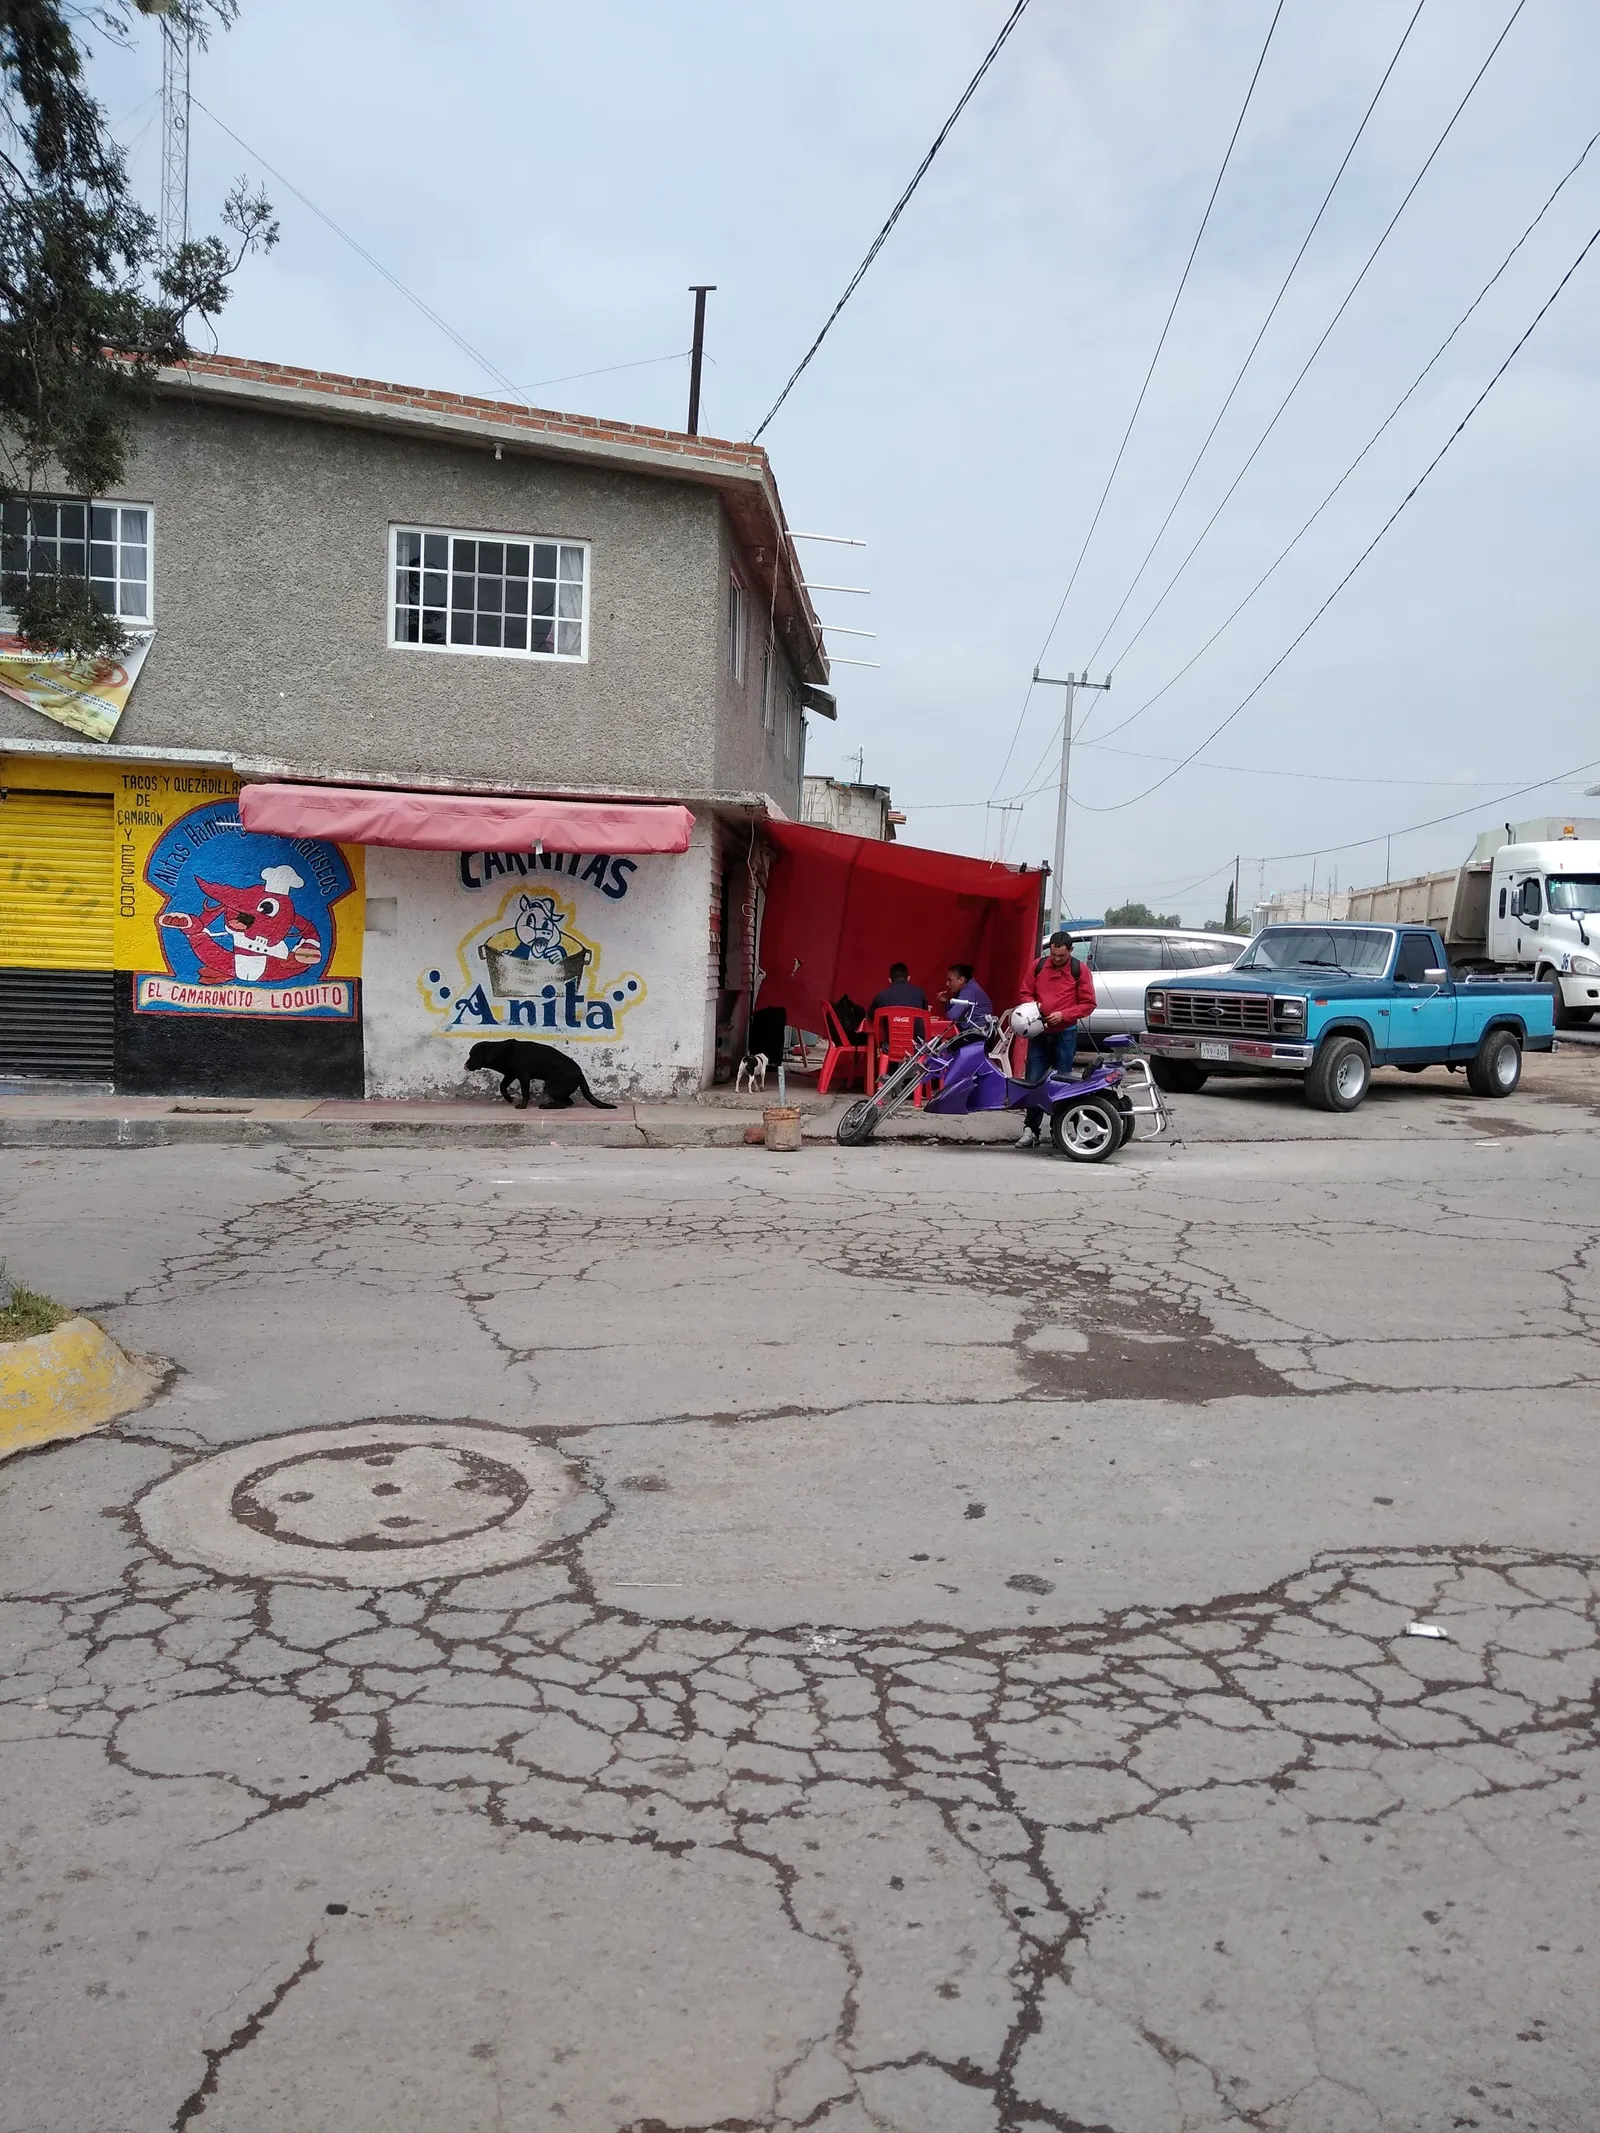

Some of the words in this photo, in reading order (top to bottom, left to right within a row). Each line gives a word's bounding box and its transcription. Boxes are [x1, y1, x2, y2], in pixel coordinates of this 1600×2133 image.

[121, 775, 158, 791] TACOS
[163, 776, 170, 791] Y
[174, 777, 247, 794] QUEZADILLA
[136, 793, 151, 807] DE
[124, 828, 133, 841] Y
[153, 843, 192, 887] Alitas
[120, 844, 136, 918] PESCADO
[148, 982, 163, 998] EL
[170, 985, 253, 1008] CAMARONCITO
[271, 987, 342, 1009] LOQUITO
[451, 977, 615, 1029] Anita
